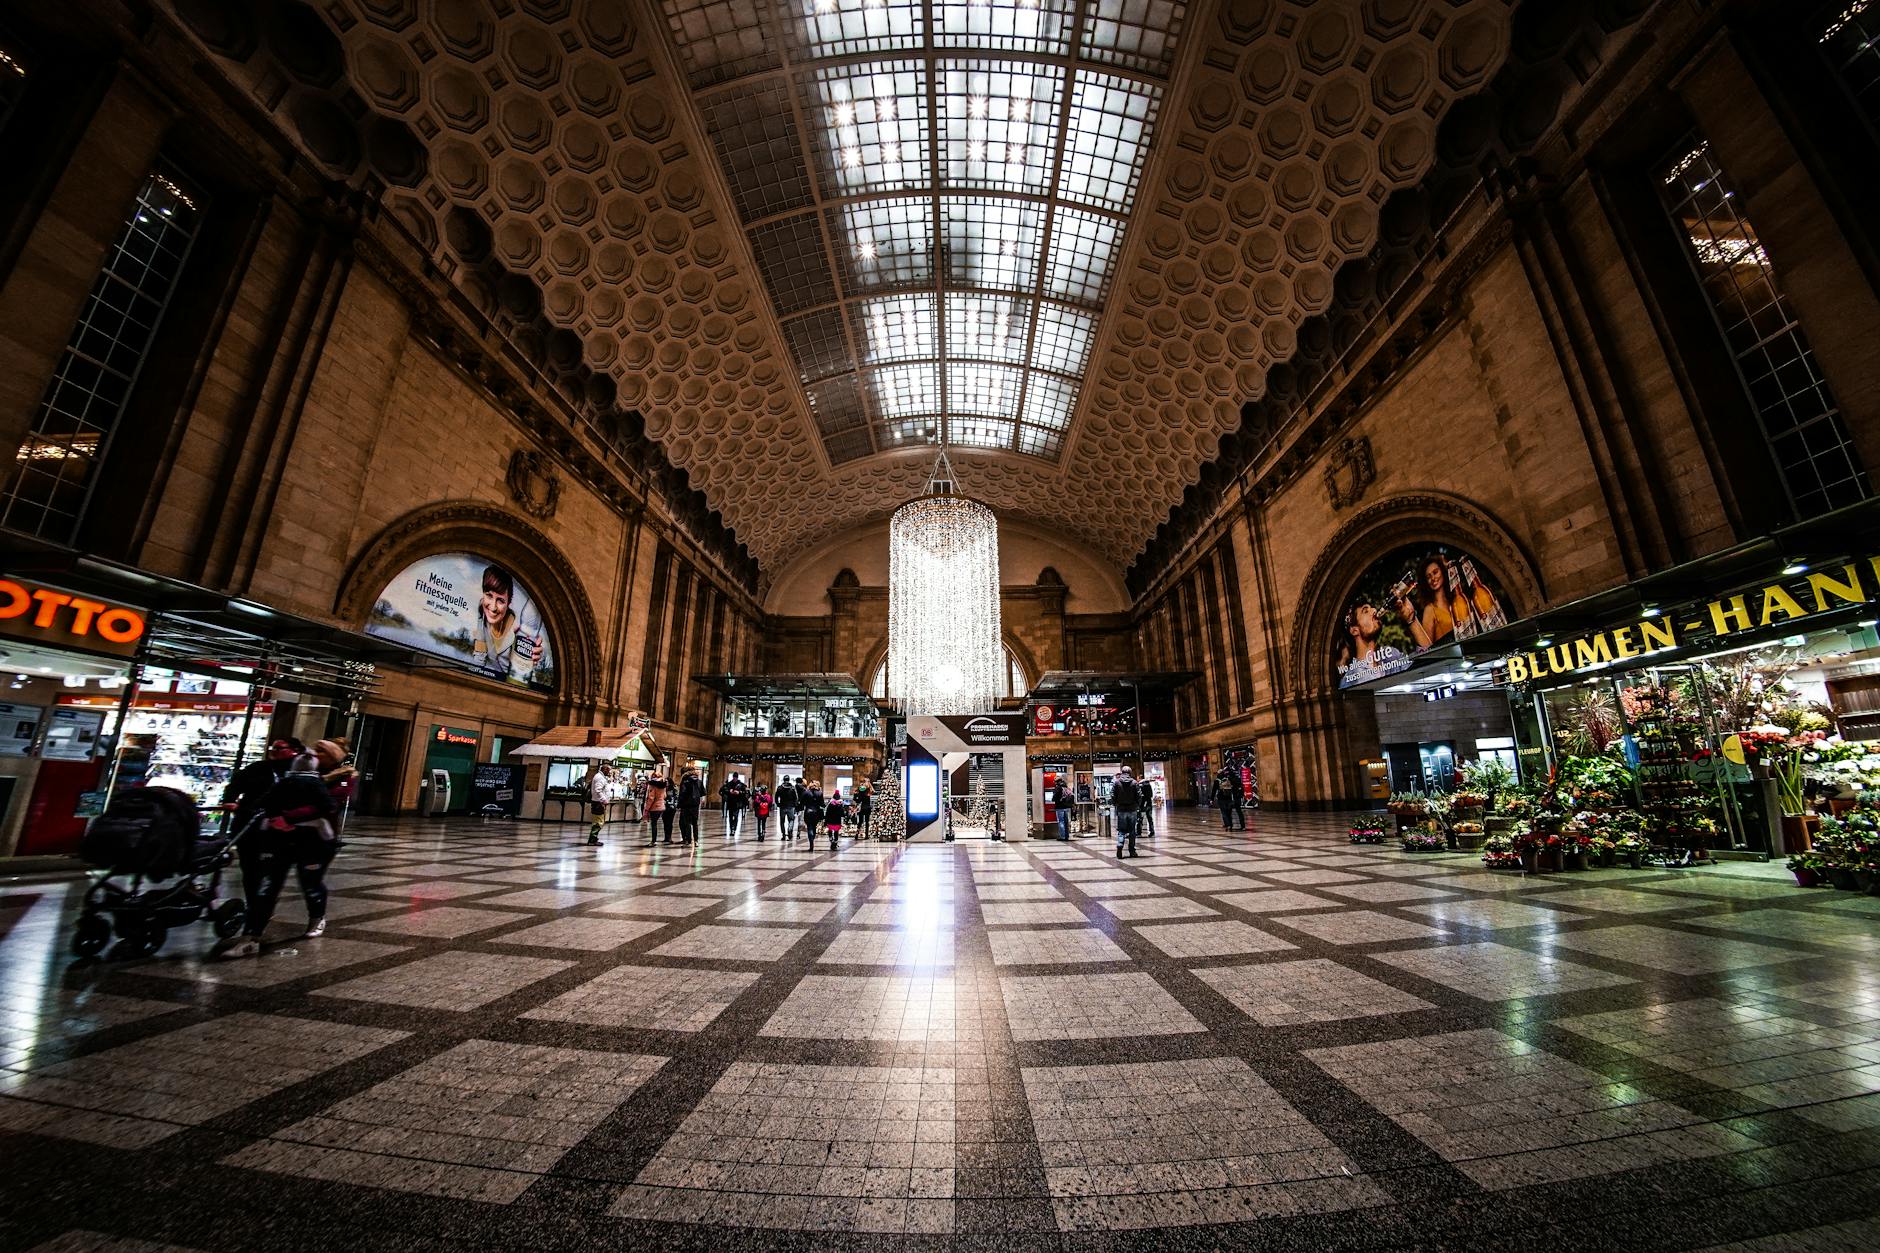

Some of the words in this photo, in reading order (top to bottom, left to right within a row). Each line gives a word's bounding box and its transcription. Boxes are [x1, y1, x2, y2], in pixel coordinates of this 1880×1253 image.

[428, 572, 453, 591] Meine
[426, 599, 435, 607] mit
[434, 601, 450, 613] jedem
[1337, 665, 1349, 675] Wo
[1349, 657, 1367, 671] alles
[1365, 645, 1393, 664] Gute
[448, 734, 477, 745] Sparkasse
